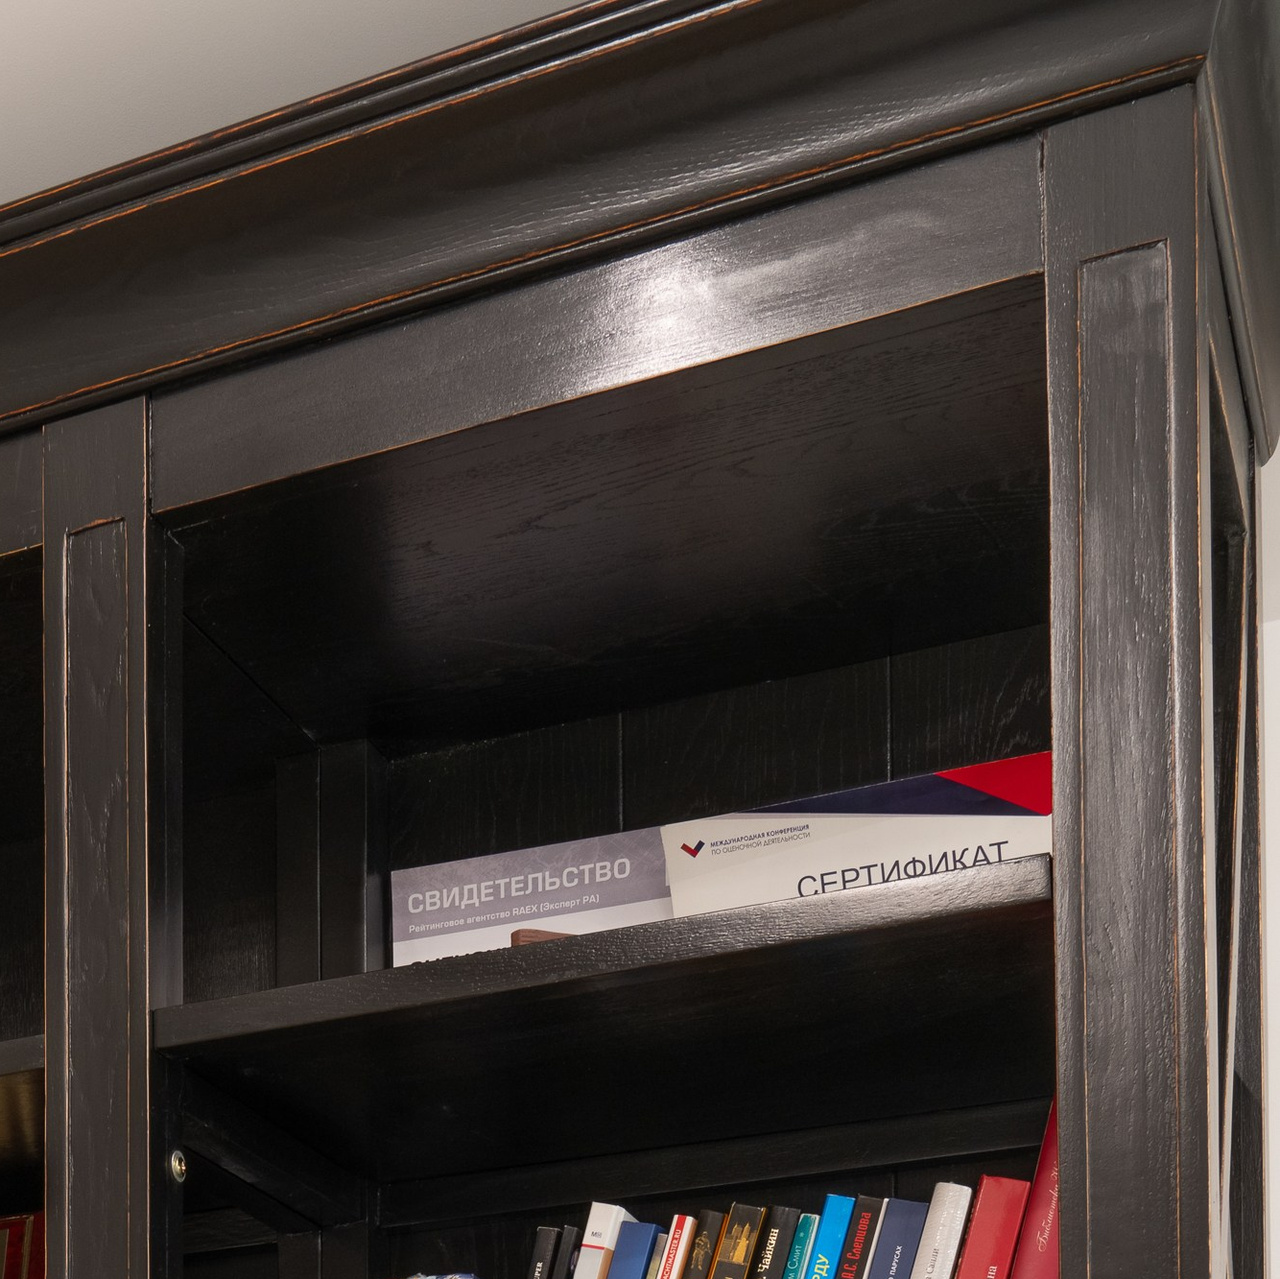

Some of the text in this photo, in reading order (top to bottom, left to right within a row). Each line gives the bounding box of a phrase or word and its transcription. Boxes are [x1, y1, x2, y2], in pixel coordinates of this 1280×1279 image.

[711, 823, 809, 848] МЕЖДУНАРОДНАЯ КОНФЕРЕНЦИЯ
[408, 858, 630, 913] СВИДЕТЕЛЬСТВО
[797, 841, 1010, 897] СЕРТИФИКАТ
[409, 894, 599, 933] Рейтинговое агентство RAEX (Эксперт РА)
[758, 1226, 780, 1273] Чайкин
